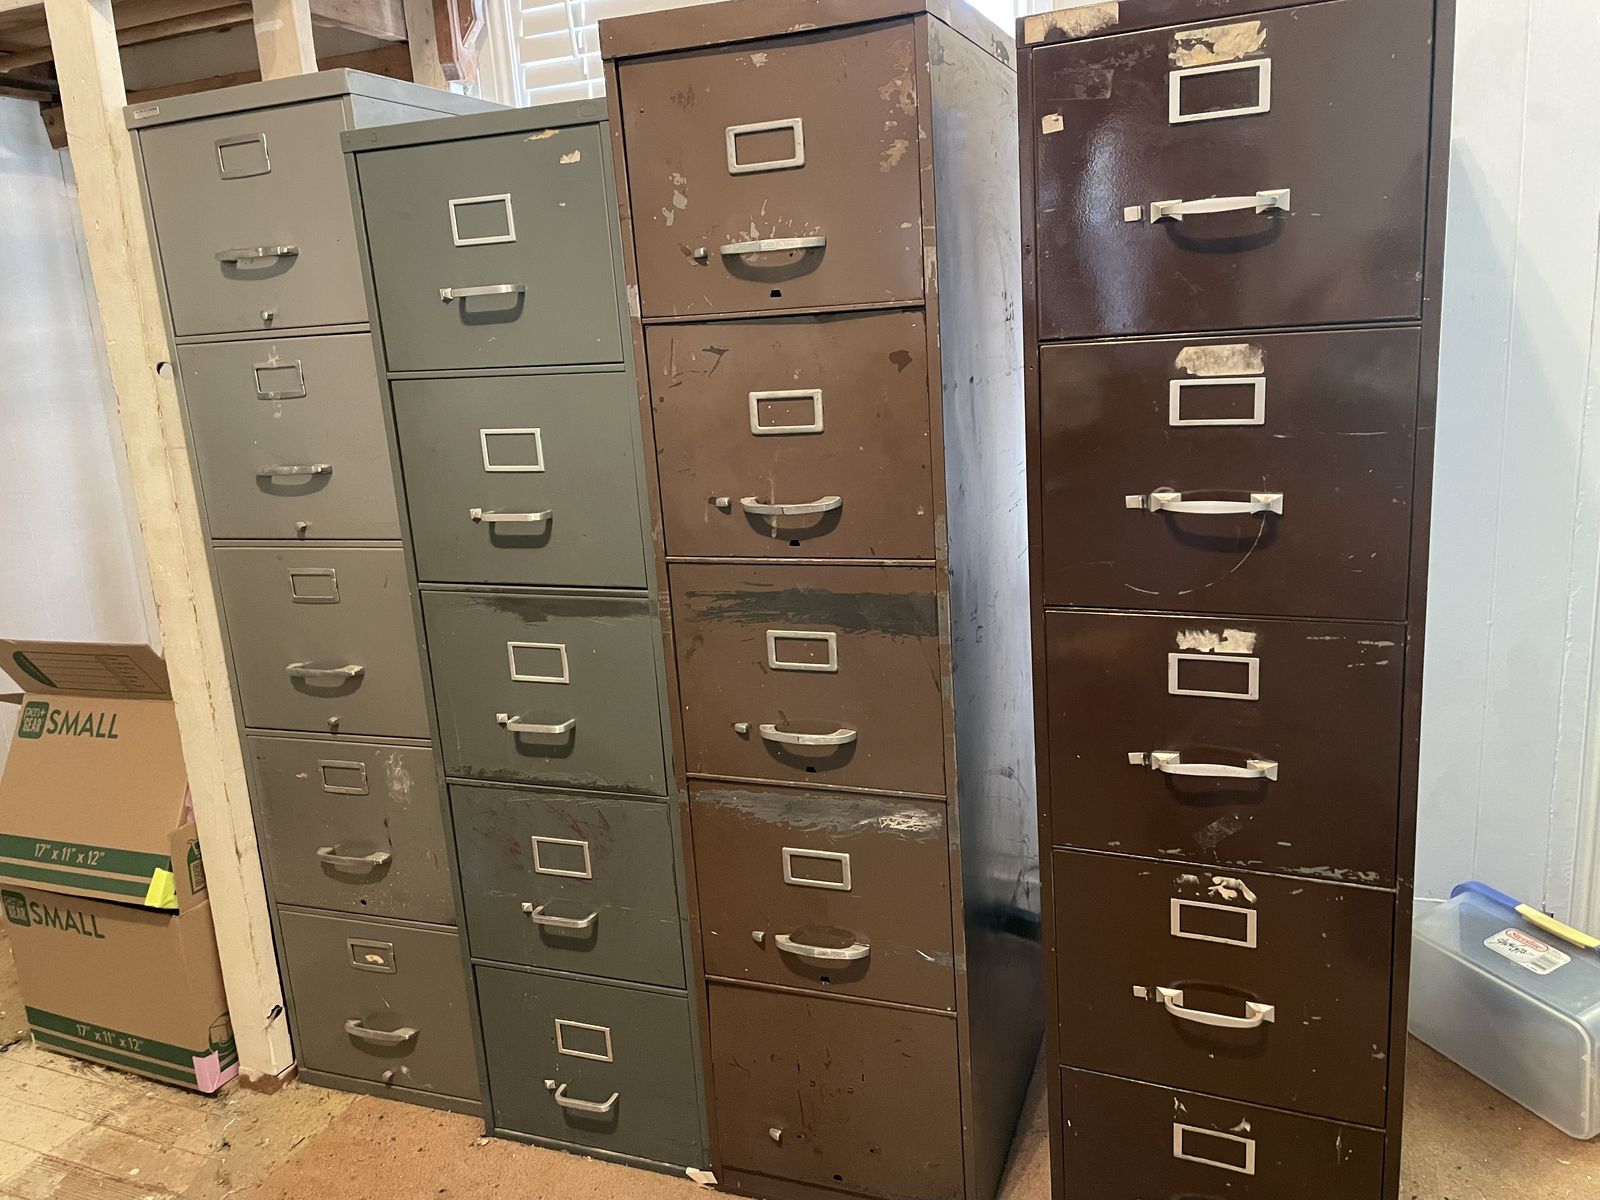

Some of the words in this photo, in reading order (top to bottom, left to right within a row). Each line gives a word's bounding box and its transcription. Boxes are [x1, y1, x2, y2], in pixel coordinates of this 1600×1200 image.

[22, 717, 42, 732] GEAR
[47, 709, 118, 739] SMALL
[34, 843, 51, 858] 17"
[51, 849, 59, 860] x
[61, 847, 76, 862] 11"
[76, 853, 85, 864] x
[87, 850, 106, 866] 12"
[30, 901, 105, 939] SMALL
[75, 1024, 91, 1037] 17"
[127, 1037, 144, 1052] 12"
